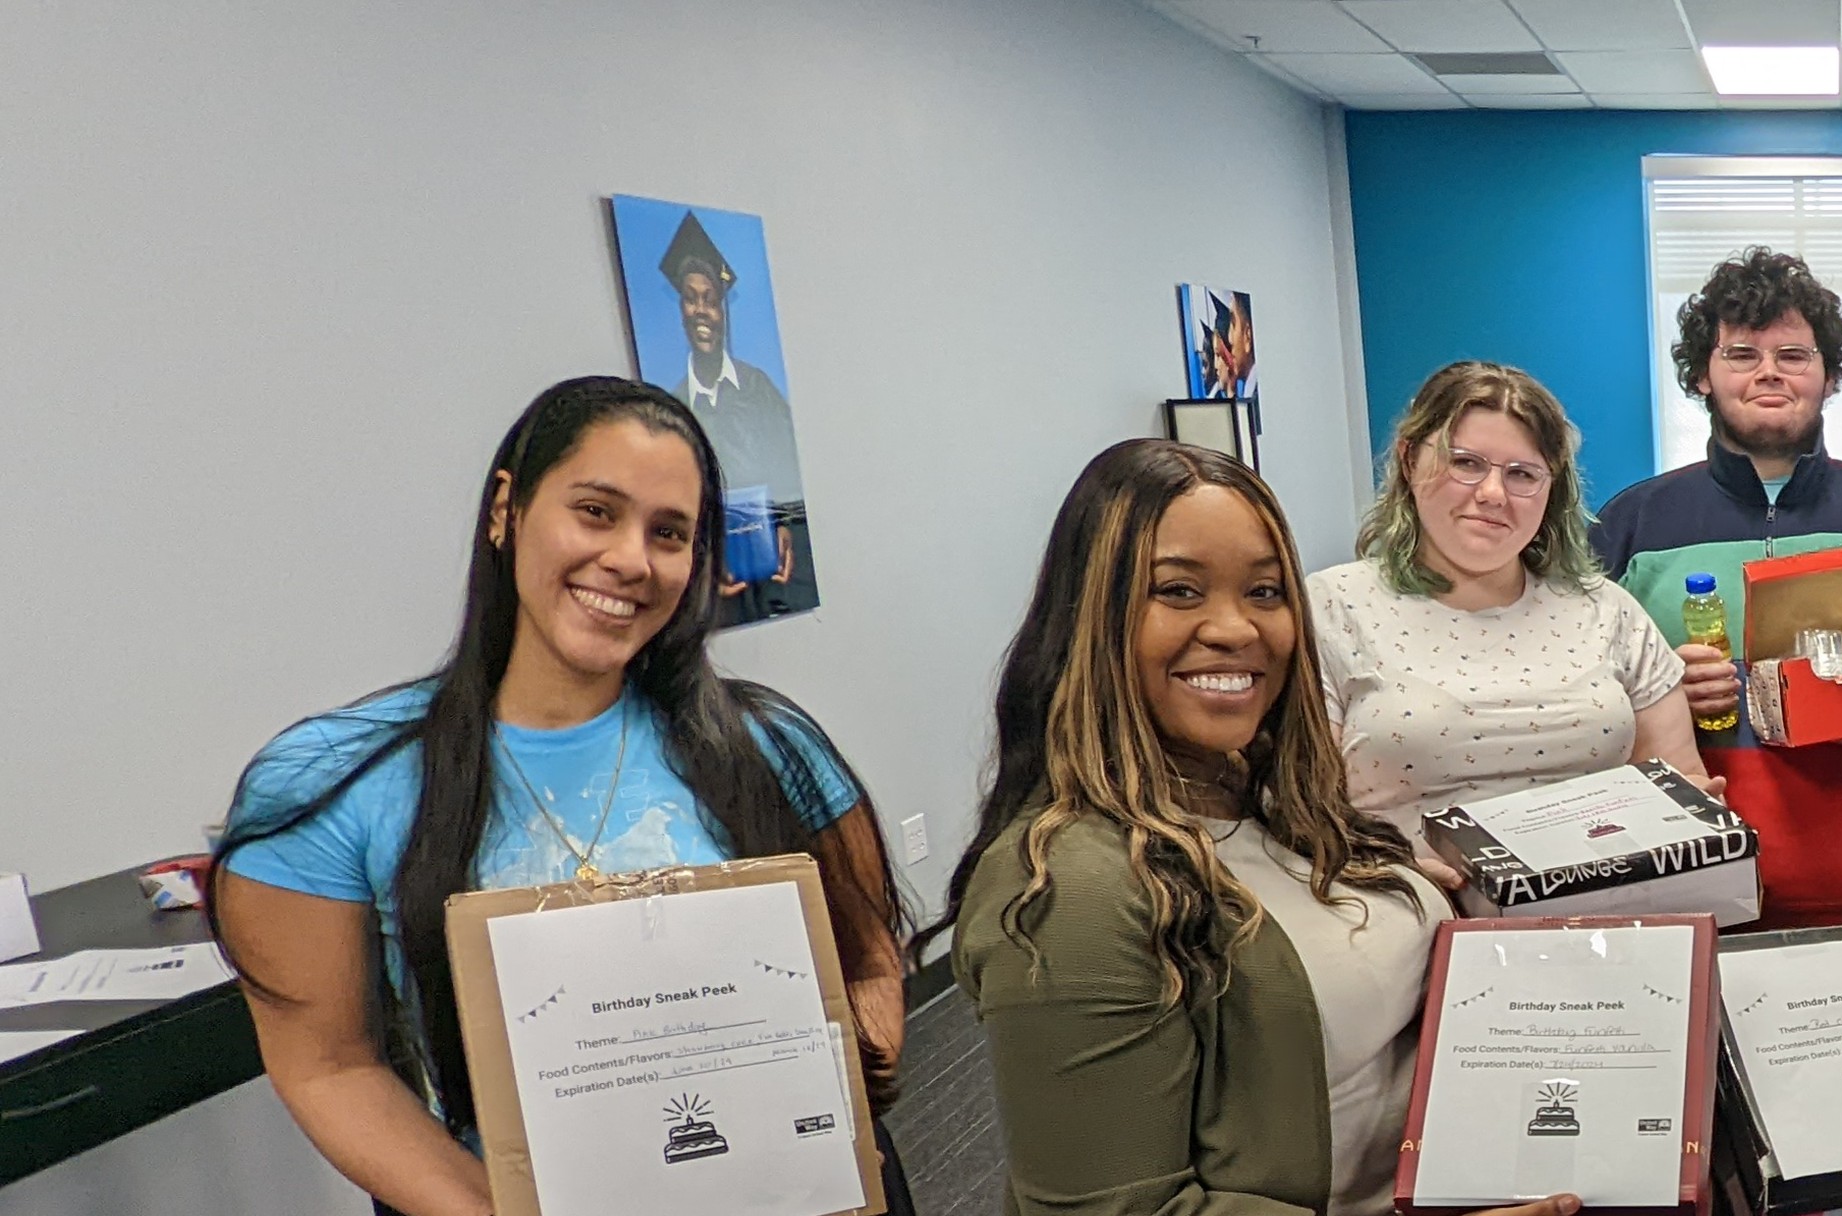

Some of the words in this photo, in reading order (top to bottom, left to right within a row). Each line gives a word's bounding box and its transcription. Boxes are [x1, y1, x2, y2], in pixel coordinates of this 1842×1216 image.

[1650, 829, 1748, 874] WILD
[1540, 856, 1632, 895] LOUNGE
[591, 997, 652, 1014] Birthday
[655, 988, 698, 1004] Sneak
[702, 983, 737, 997] Peek
[1787, 998, 1828, 1010] Birthday
[1509, 1001, 1556, 1013] Birthday
[1559, 1001, 1593, 1011] Sneak
[1597, 1000, 1625, 1010] Peek
[1453, 1045, 1477, 1053] Food
[1756, 1044, 1777, 1054] Food
[1461, 1060, 1510, 1070] Expiration
[1769, 1053, 1810, 1066] Expiration
[538, 1066, 569, 1081] Food
[555, 1078, 614, 1099] Expiration
